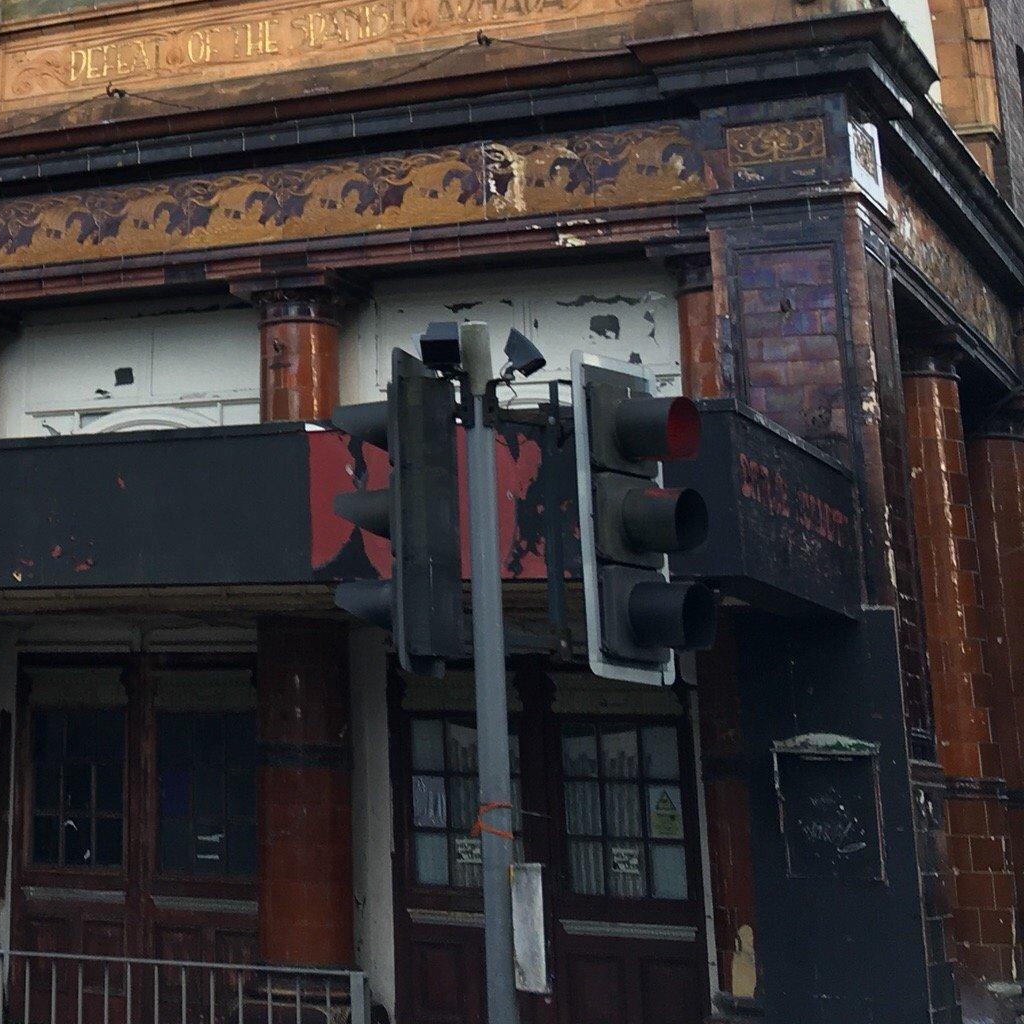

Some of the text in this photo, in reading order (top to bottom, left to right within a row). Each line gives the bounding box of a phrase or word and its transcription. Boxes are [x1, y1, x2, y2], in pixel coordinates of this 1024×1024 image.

[70, 37, 163, 82] DEFEAT
[187, 26, 218, 65] OF
[228, 18, 280, 59] THE
